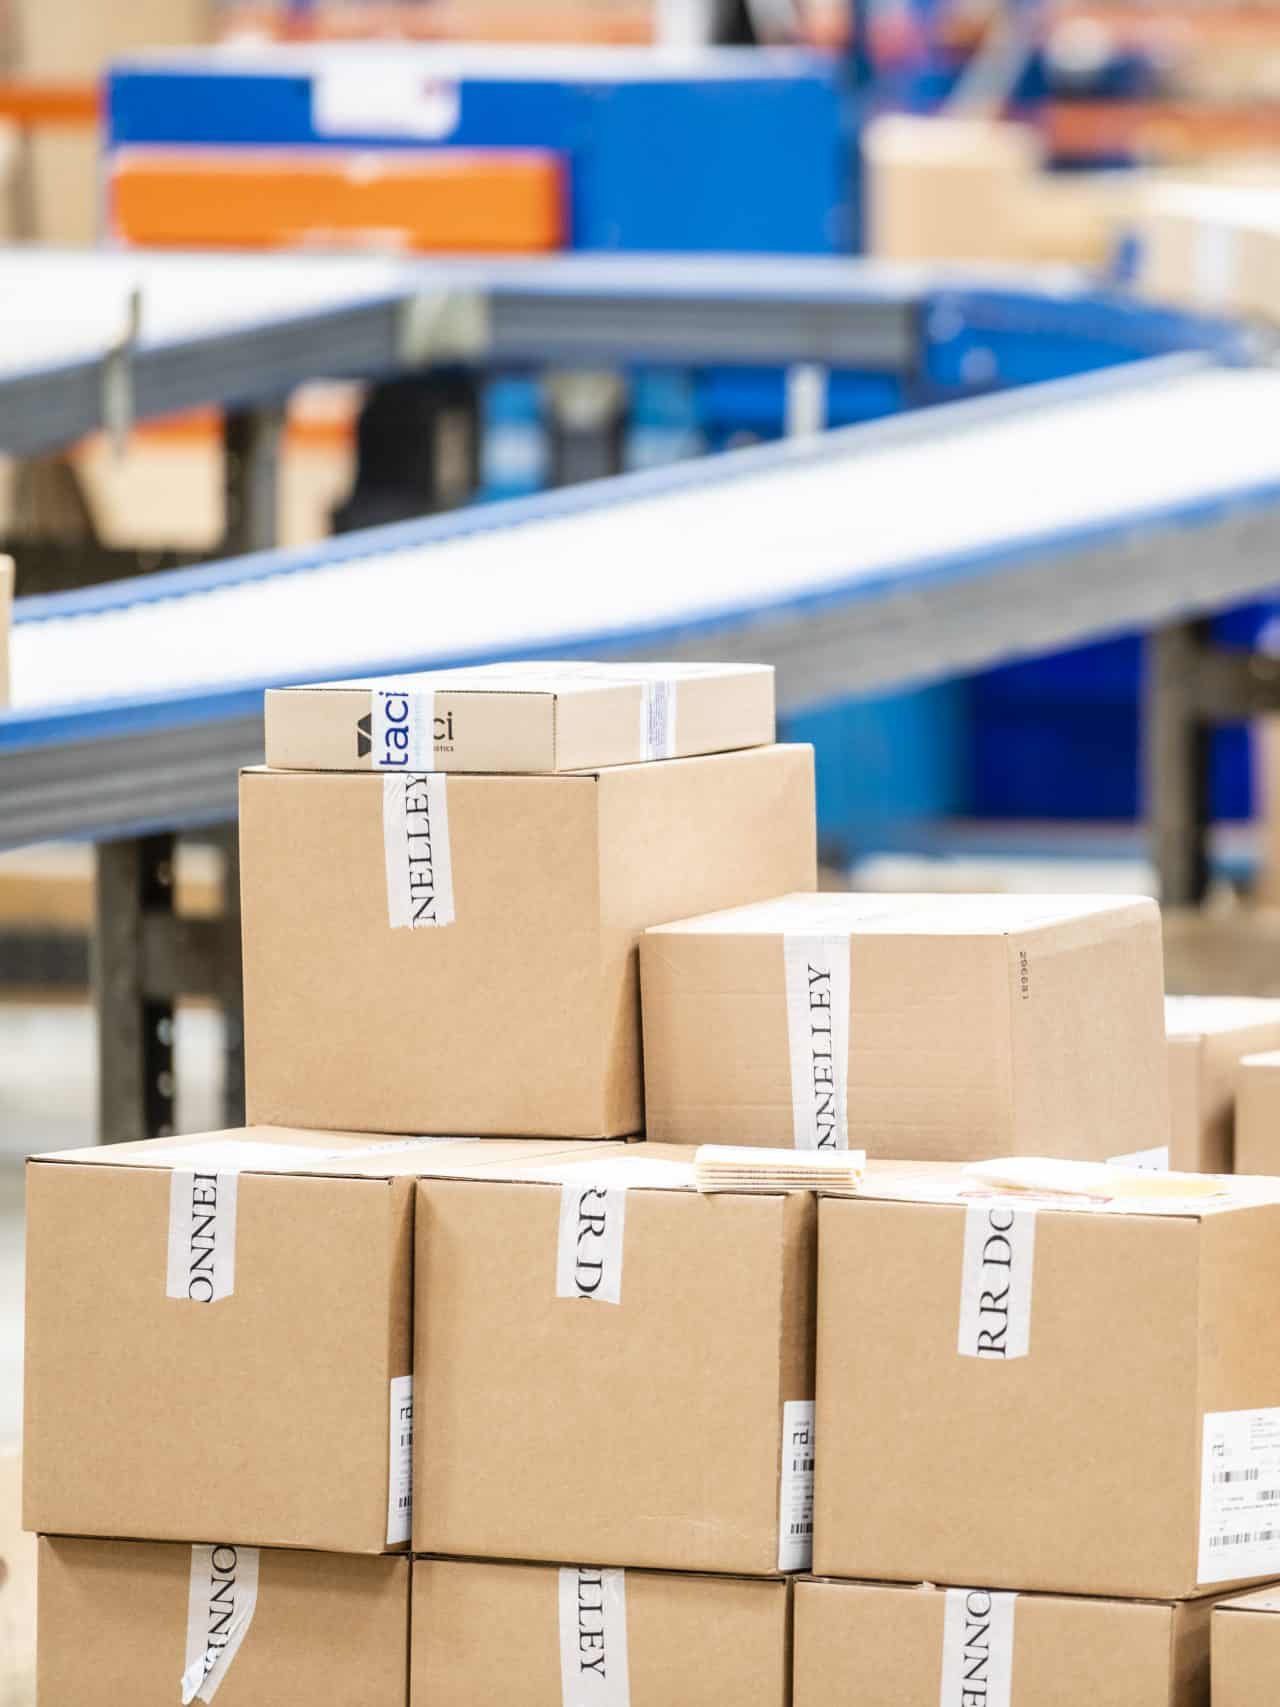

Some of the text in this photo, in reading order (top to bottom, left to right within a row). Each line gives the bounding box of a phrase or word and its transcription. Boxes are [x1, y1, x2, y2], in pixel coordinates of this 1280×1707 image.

[379, 691, 409, 766] taci
[574, 1256, 604, 1299] D
[976, 1283, 1011, 1359] RR
[577, 1567, 606, 1680] LLEY
